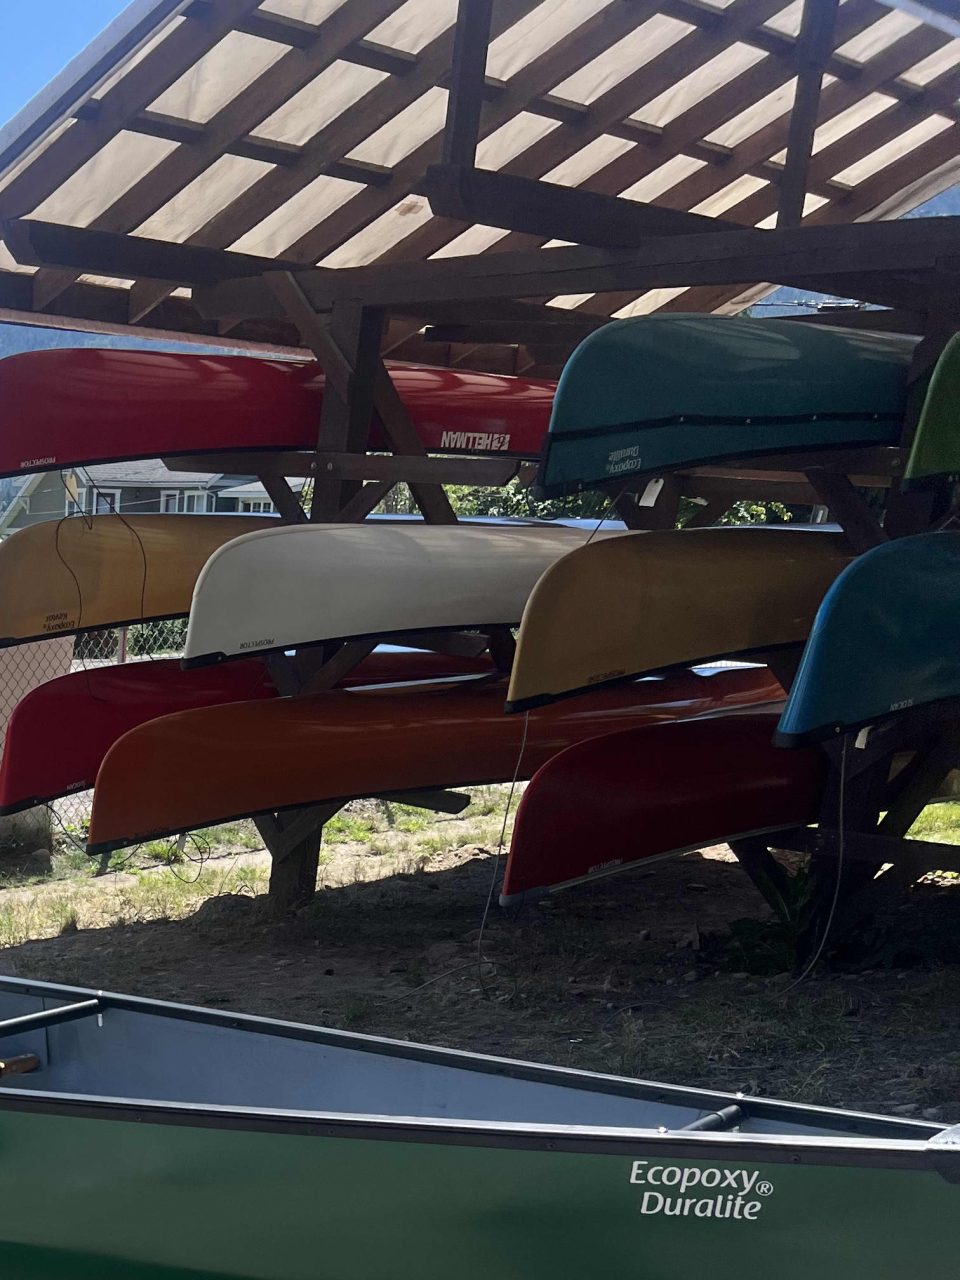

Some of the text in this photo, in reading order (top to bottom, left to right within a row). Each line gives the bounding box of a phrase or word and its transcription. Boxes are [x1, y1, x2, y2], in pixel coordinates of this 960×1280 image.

[440, 431, 492, 450] HELLMAN
[19, 456, 56, 468] PROSPECTOR
[640, 1191, 762, 1220] Duralite
